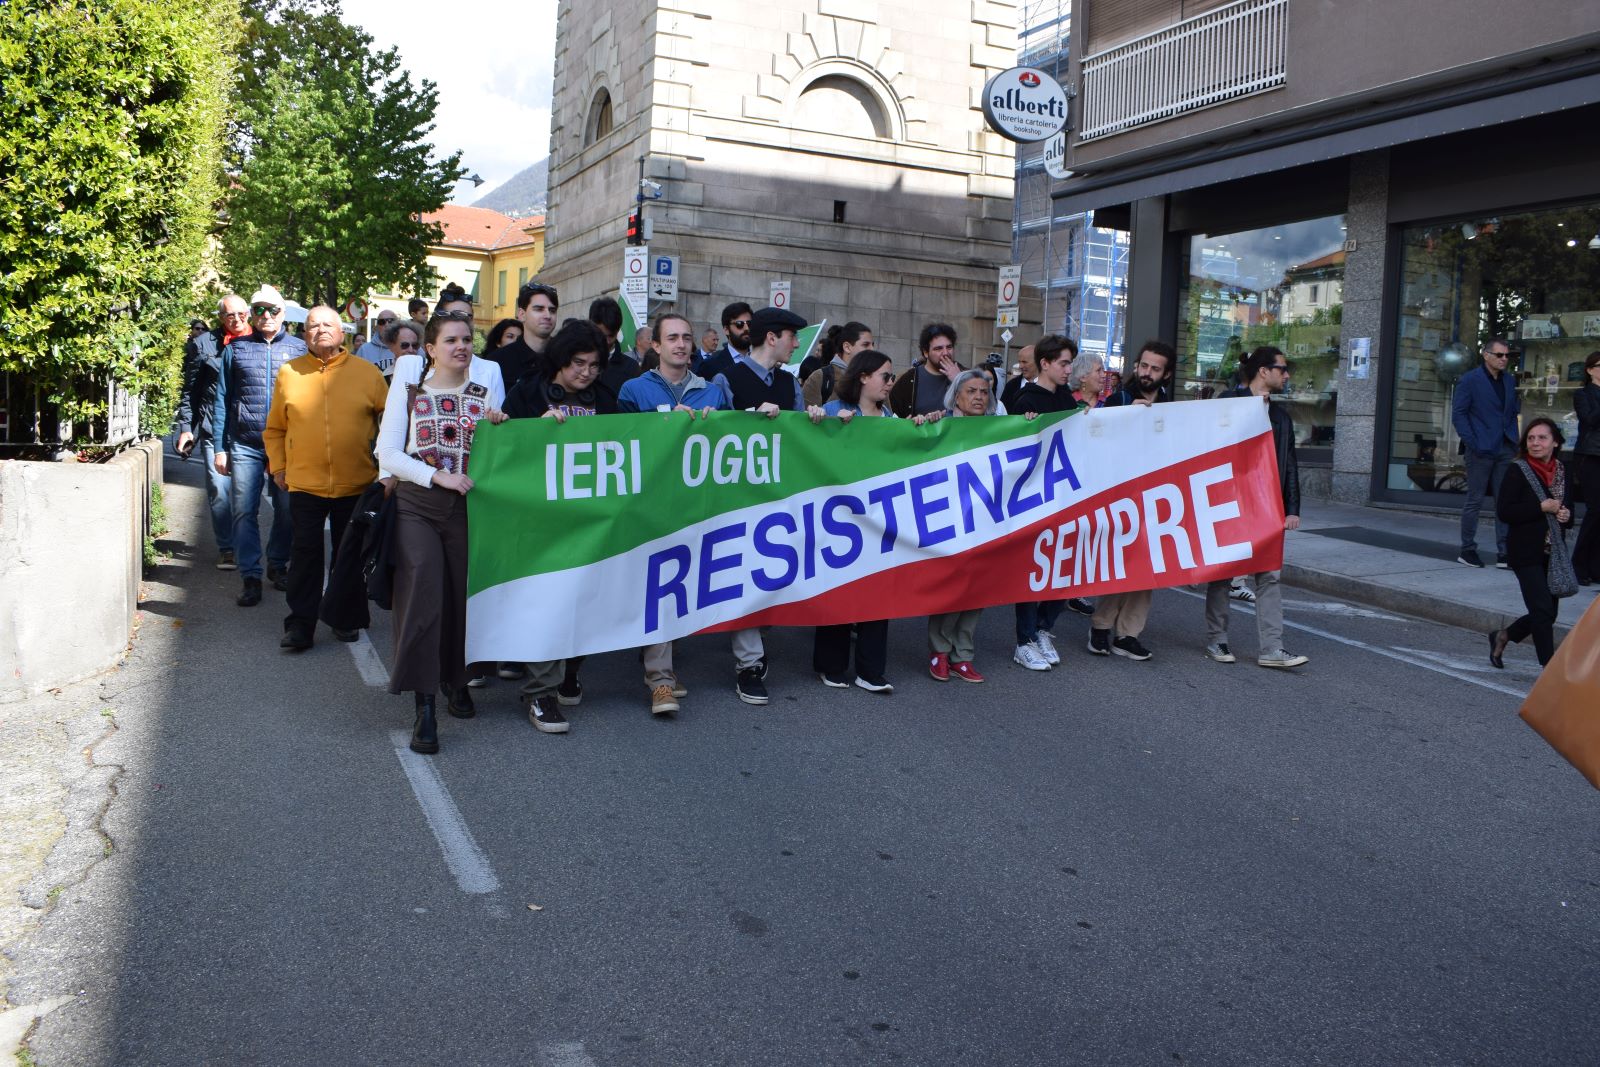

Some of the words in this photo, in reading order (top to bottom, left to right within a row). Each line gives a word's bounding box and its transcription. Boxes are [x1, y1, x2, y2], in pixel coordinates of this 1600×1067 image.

[992, 88, 1064, 119] alberti
[998, 113, 1023, 123] libreria
[1026, 119, 1057, 129] cartoleria
[1014, 125, 1041, 136] bookshop
[660, 262, 668, 272] P
[545, 439, 642, 501] IERI
[682, 433, 782, 488] OGGI
[645, 429, 1081, 634] RESISTENZA
[1029, 462, 1253, 592] SEMPRE
